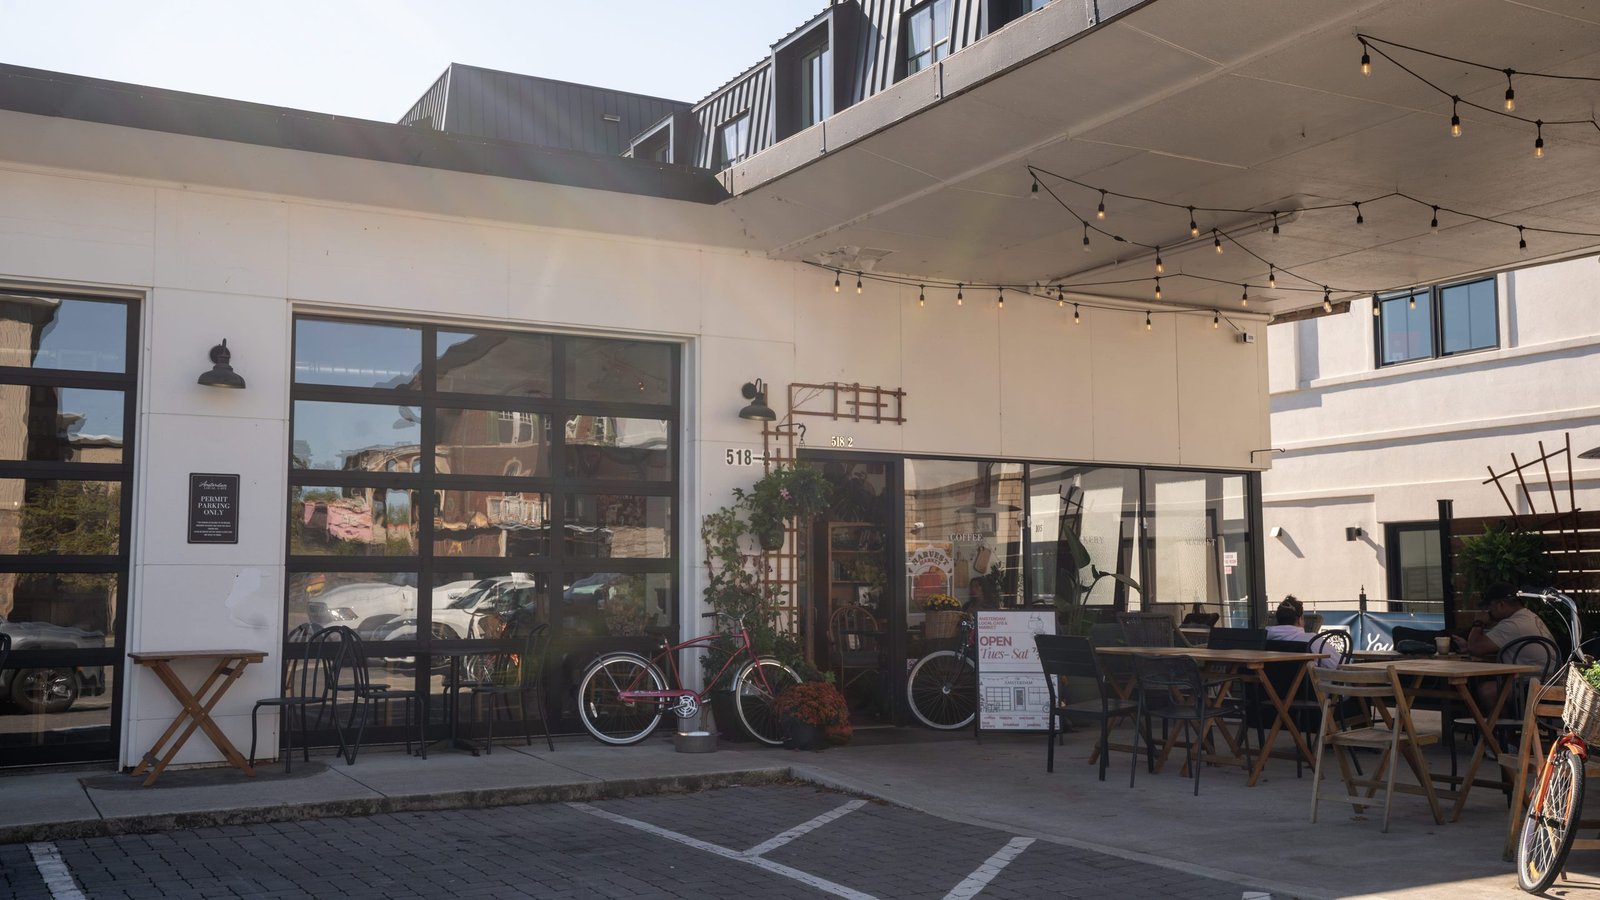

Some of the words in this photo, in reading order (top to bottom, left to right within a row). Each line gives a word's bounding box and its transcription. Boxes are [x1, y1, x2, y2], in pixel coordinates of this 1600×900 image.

[831, 436, 845, 447] 518
[848, 437, 853, 447] 2
[950, 532, 982, 541] COFFEE
[912, 550, 949, 566] HARVEST
[980, 636, 1012, 646] OPEN
[1011, 648, 1029, 659] Sat
